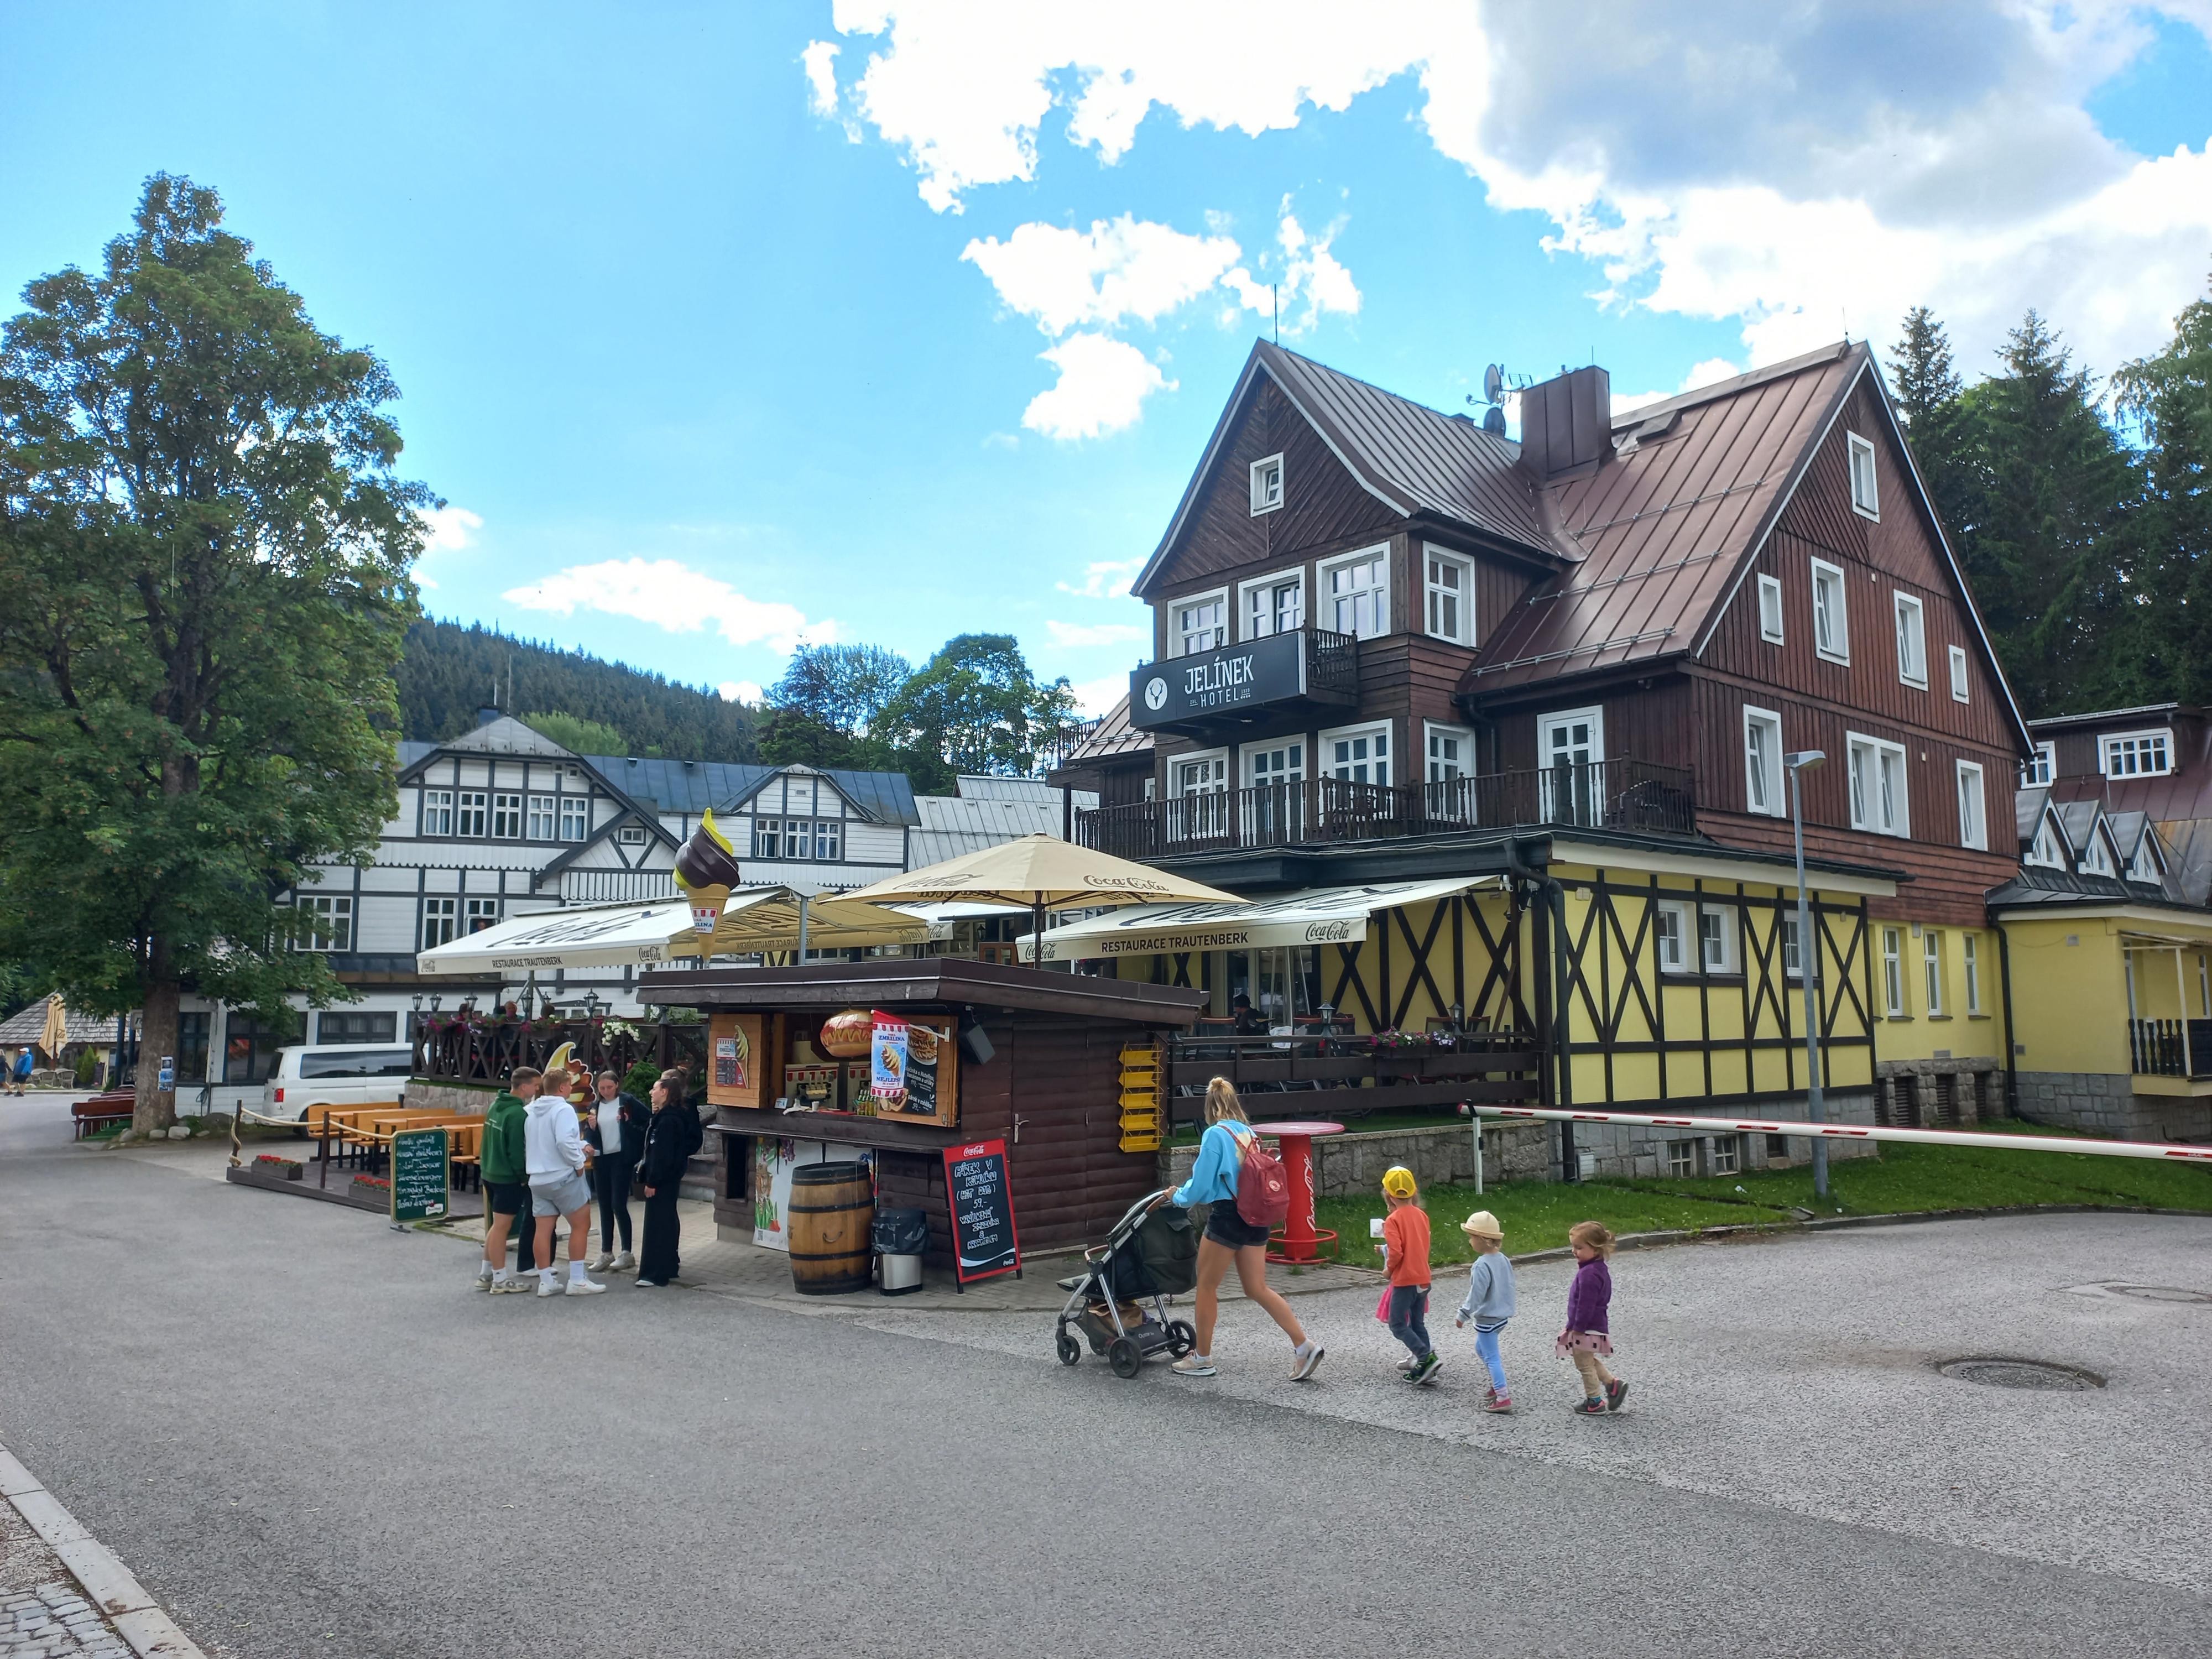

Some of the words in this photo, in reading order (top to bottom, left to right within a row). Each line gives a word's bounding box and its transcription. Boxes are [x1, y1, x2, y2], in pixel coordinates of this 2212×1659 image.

[1185, 655, 1254, 694] JELÍNEK
[1200, 687, 1239, 708] HOTEL
[1083, 875, 1169, 891] Coca-Cola
[1305, 921, 1350, 942] Coca-Cola
[1101, 937, 1166, 953] RESTAURACE
[1169, 932, 1249, 948] TRAUTENBERK
[492, 958, 523, 968] RESTAURACE
[523, 956, 563, 967] TRAUTENBERK
[639, 946, 661, 962] Coca-Cola
[963, 1145, 984, 1157] Coca-Cola
[985, 1159, 993, 1170] V
